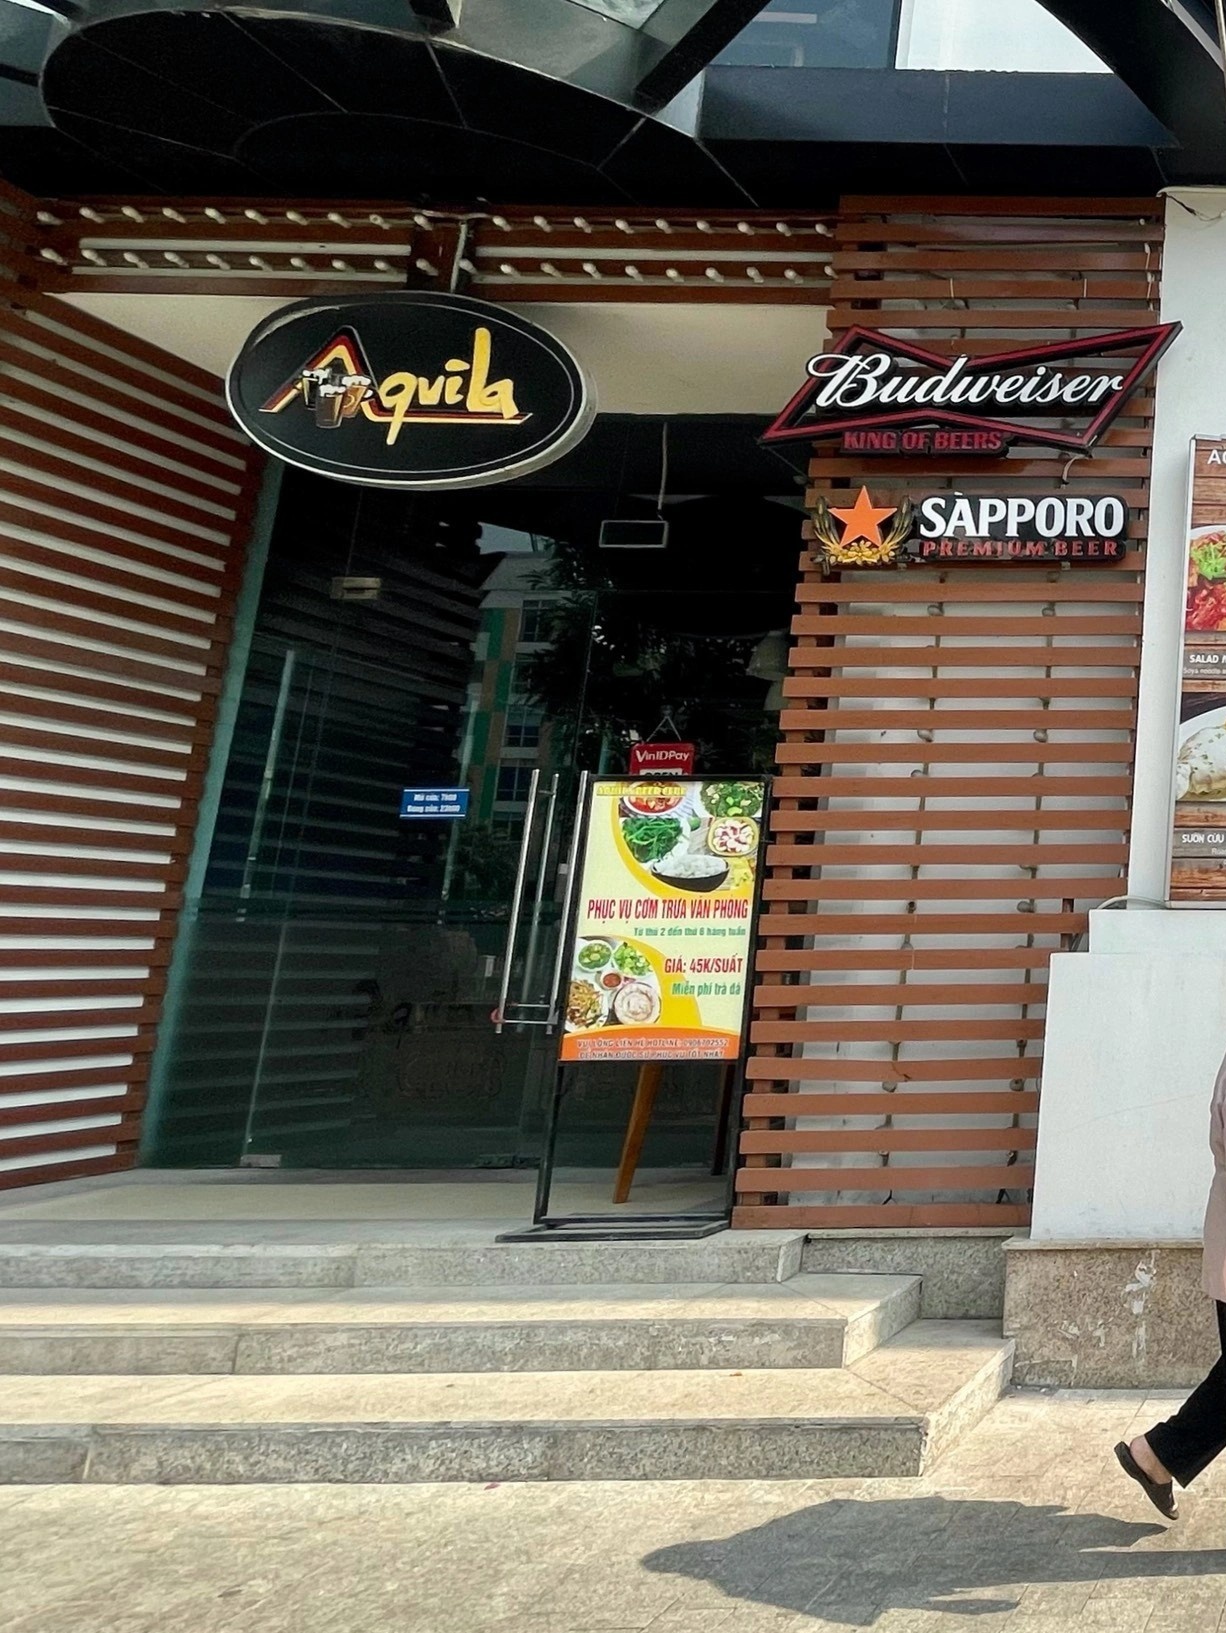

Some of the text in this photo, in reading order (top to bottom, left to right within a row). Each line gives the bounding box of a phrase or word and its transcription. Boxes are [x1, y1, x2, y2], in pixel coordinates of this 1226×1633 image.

[259, 325, 533, 445] Aquila
[807, 353, 1124, 407] Budweiser
[843, 430, 1001, 450] KING OF BEERS
[920, 495, 1124, 538] SAPPORO
[922, 540, 1118, 557] PREMIUM BEER
[1189, 654, 1219, 663] SALAD
[587, 899, 615, 924] PHỤC
[619, 899, 633, 924] VỤ
[635, 897, 658, 919] CƠM
[662, 898, 686, 919] TRƯA
[713, 895, 749, 919] PHÒNG
[660, 927, 665, 936] 2
[664, 953, 743, 974] GIÁ: 45K/SUẤT
[697, 983, 712, 998] phí
